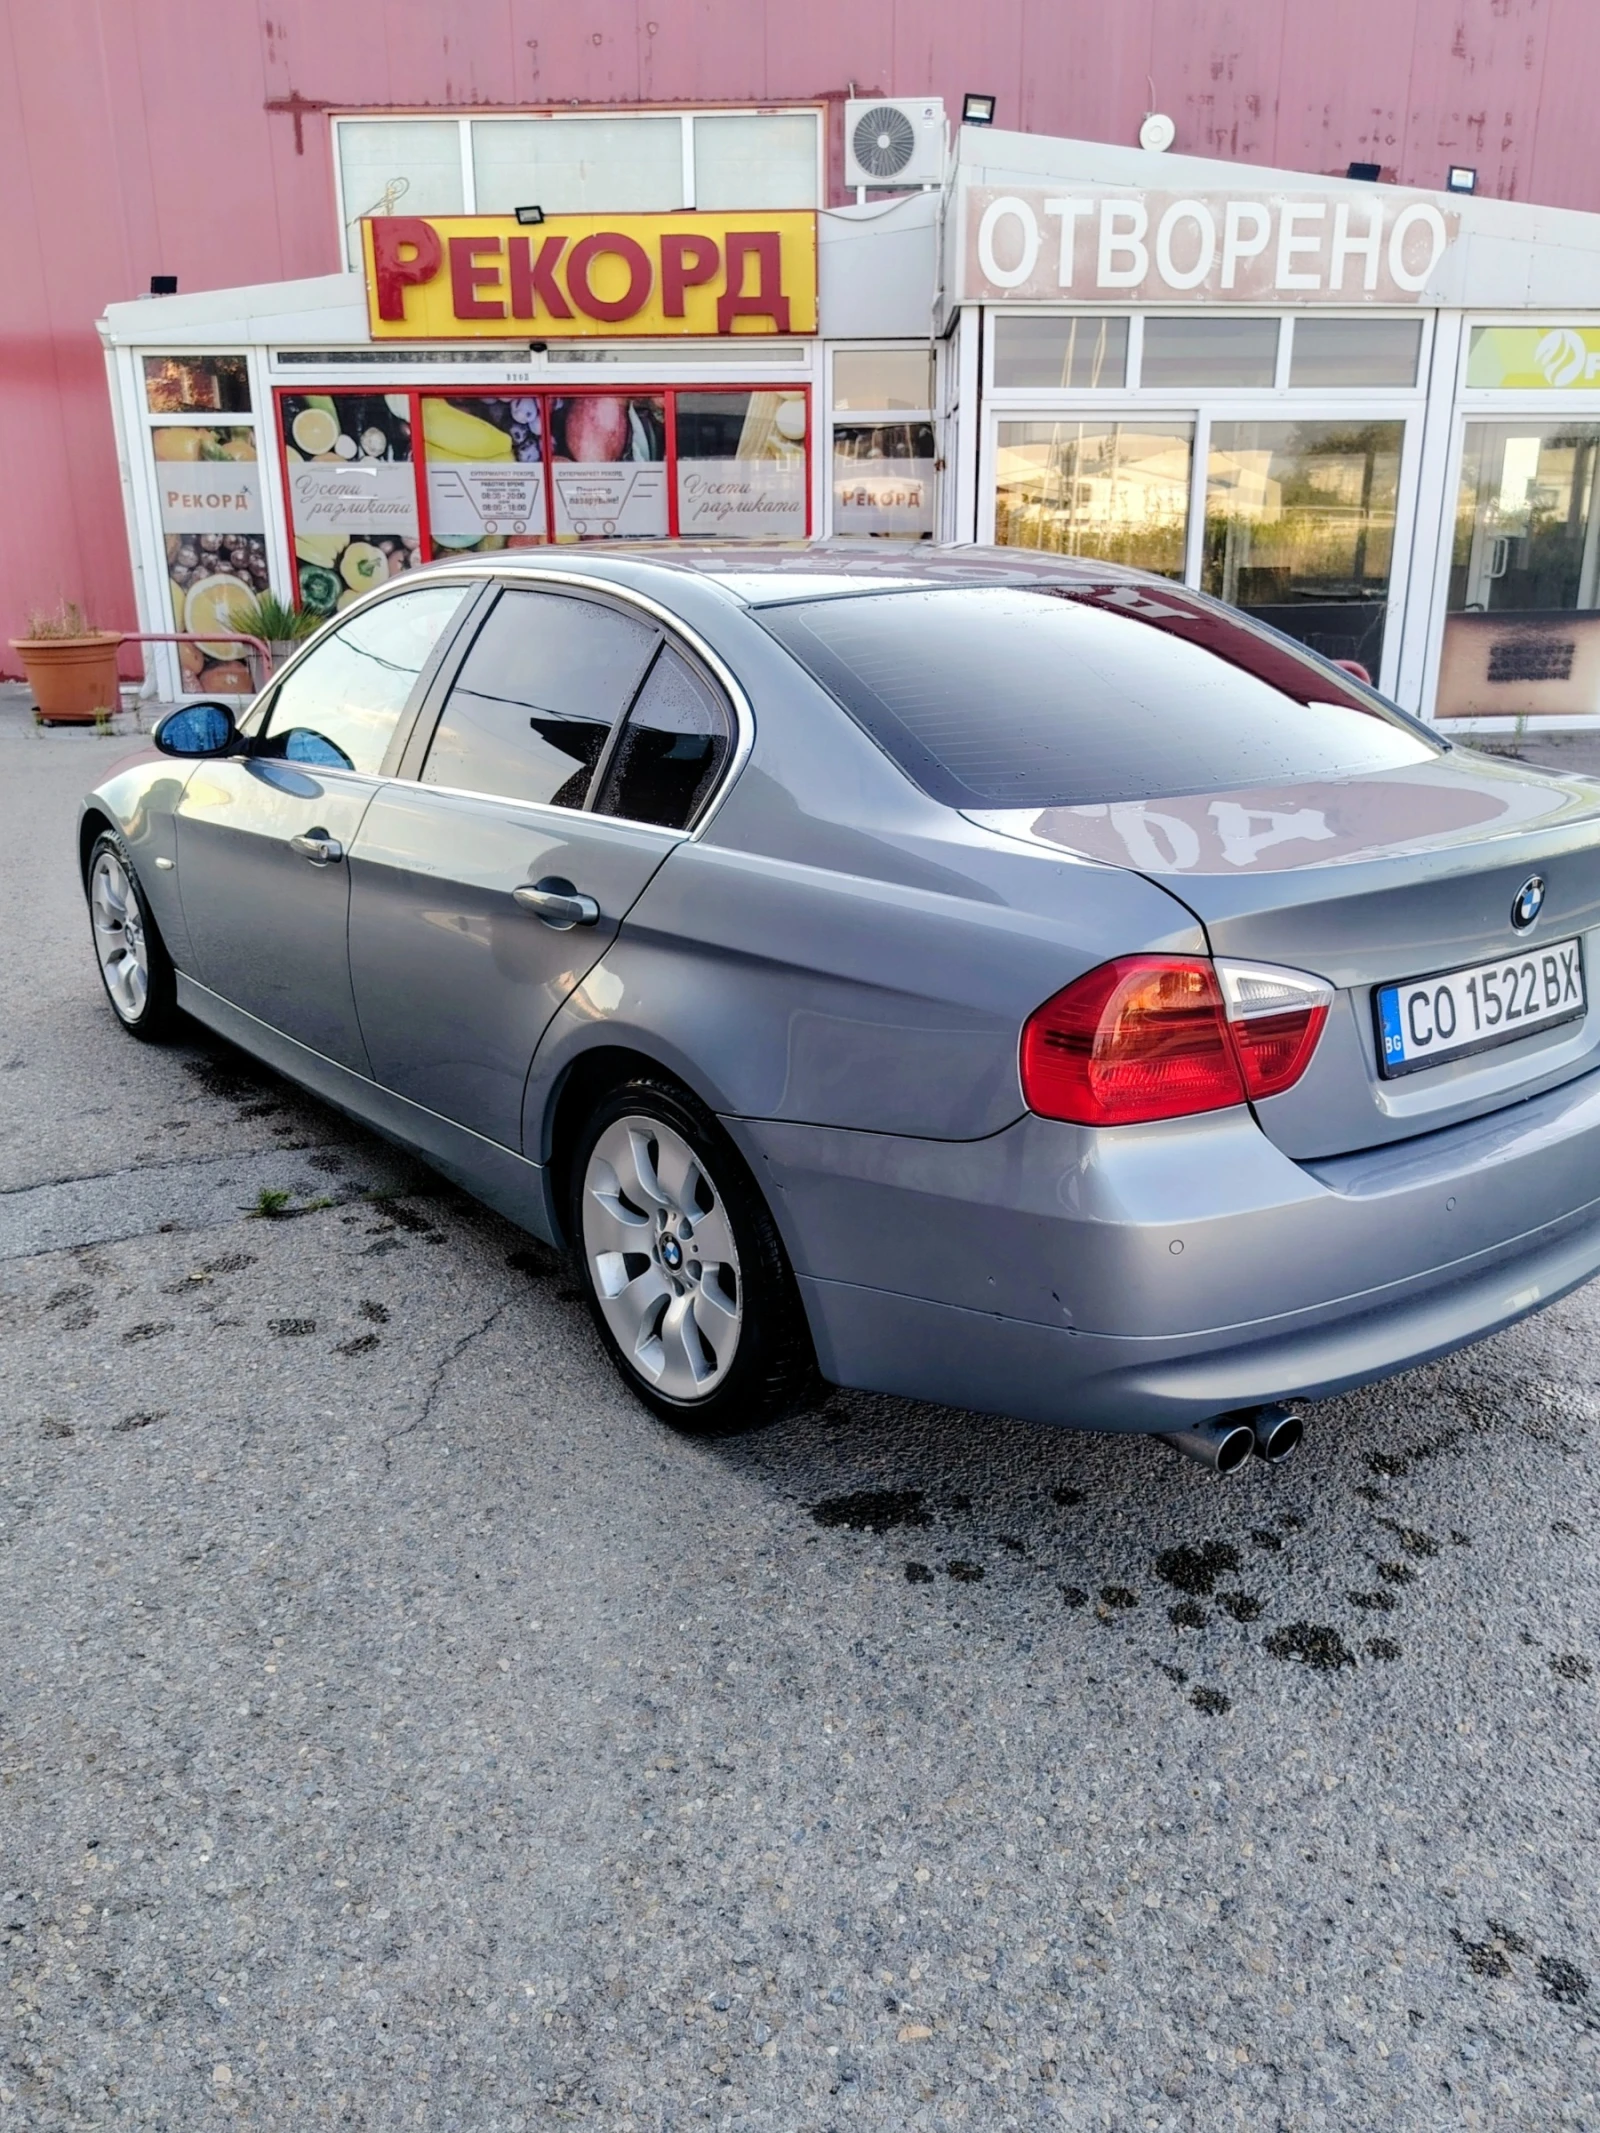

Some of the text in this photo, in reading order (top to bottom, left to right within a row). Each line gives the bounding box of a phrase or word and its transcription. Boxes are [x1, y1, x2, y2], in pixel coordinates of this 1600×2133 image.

[978, 197, 1447, 292] ОТВОРЕНО
[371, 218, 790, 333] РЕКОРД
[167, 491, 248, 510] РЕКОРД
[683, 474, 751, 503] Усети
[842, 491, 920, 508] РЕКОРД
[306, 494, 412, 522] разликата
[692, 493, 801, 521] разликата
[1466, 961, 1540, 1031] 1522
[1385, 1036, 1402, 1054] BG
